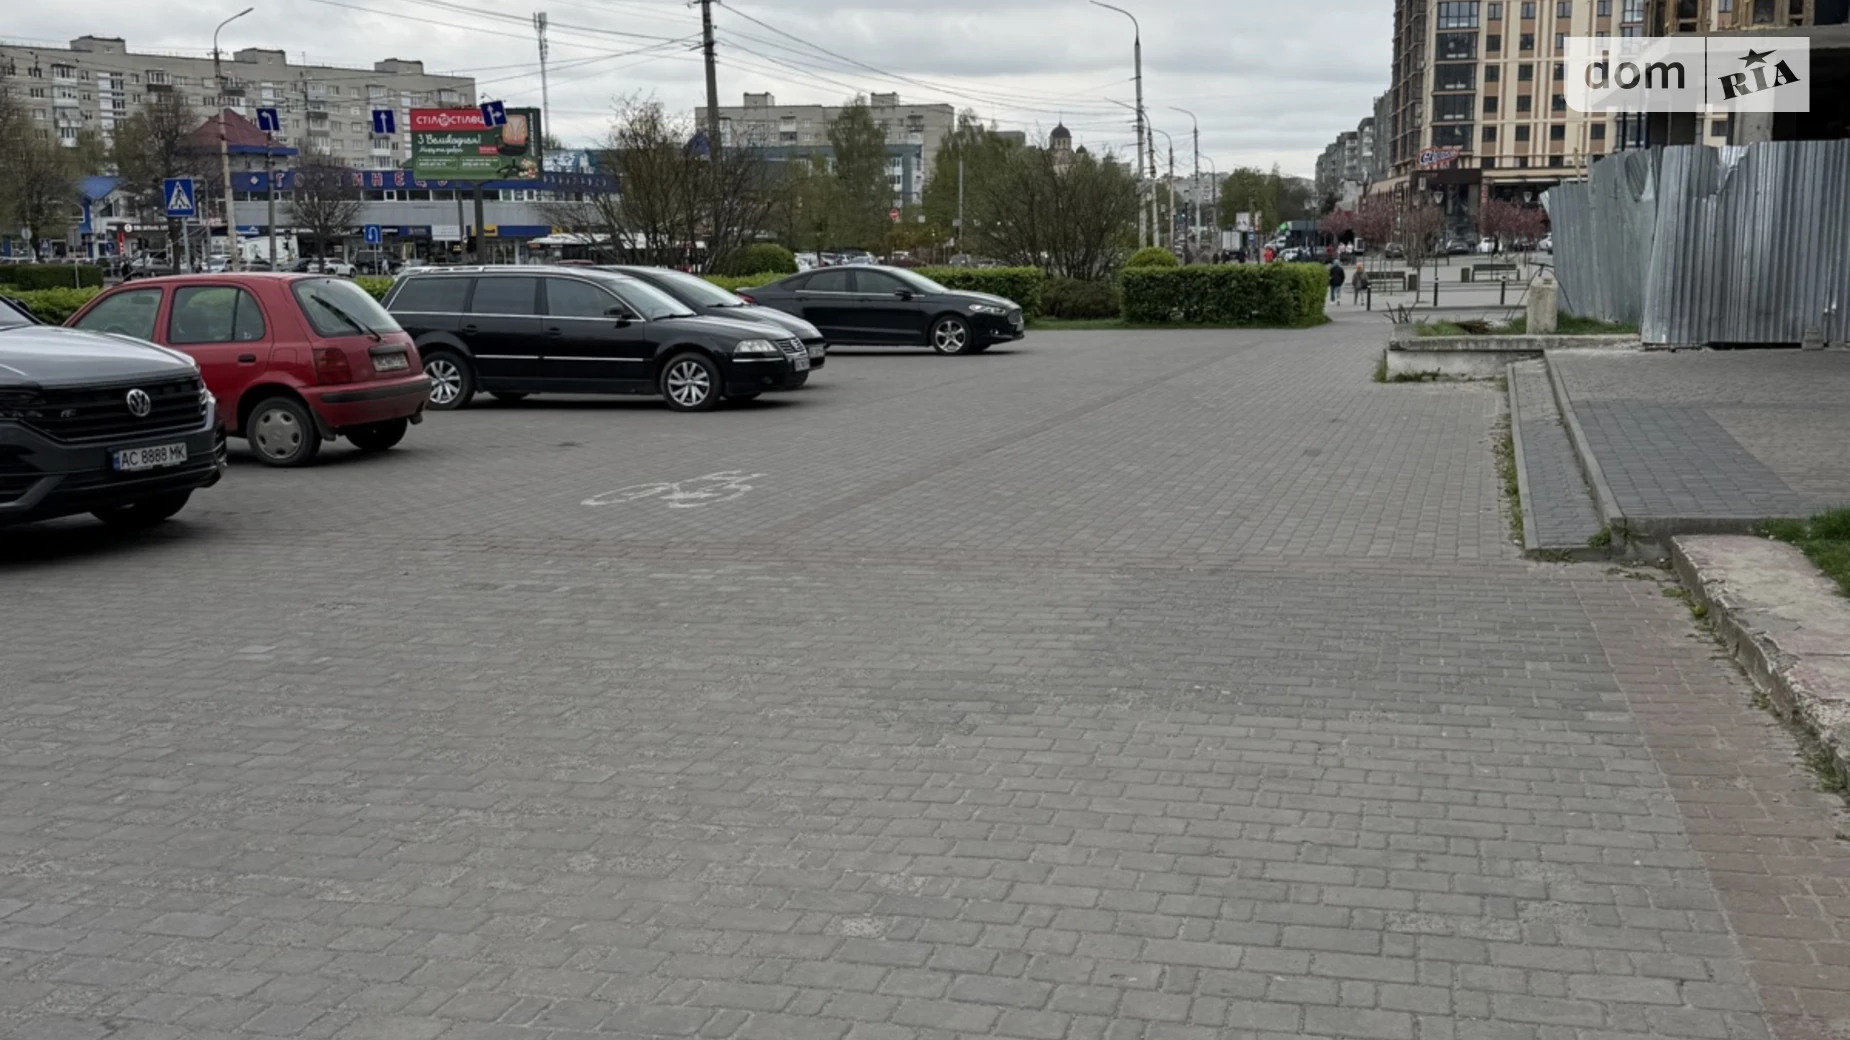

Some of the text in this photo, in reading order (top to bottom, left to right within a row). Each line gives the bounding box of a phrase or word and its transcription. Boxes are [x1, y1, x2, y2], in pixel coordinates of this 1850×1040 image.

[121, 444, 186, 467] AC 8888 MK
